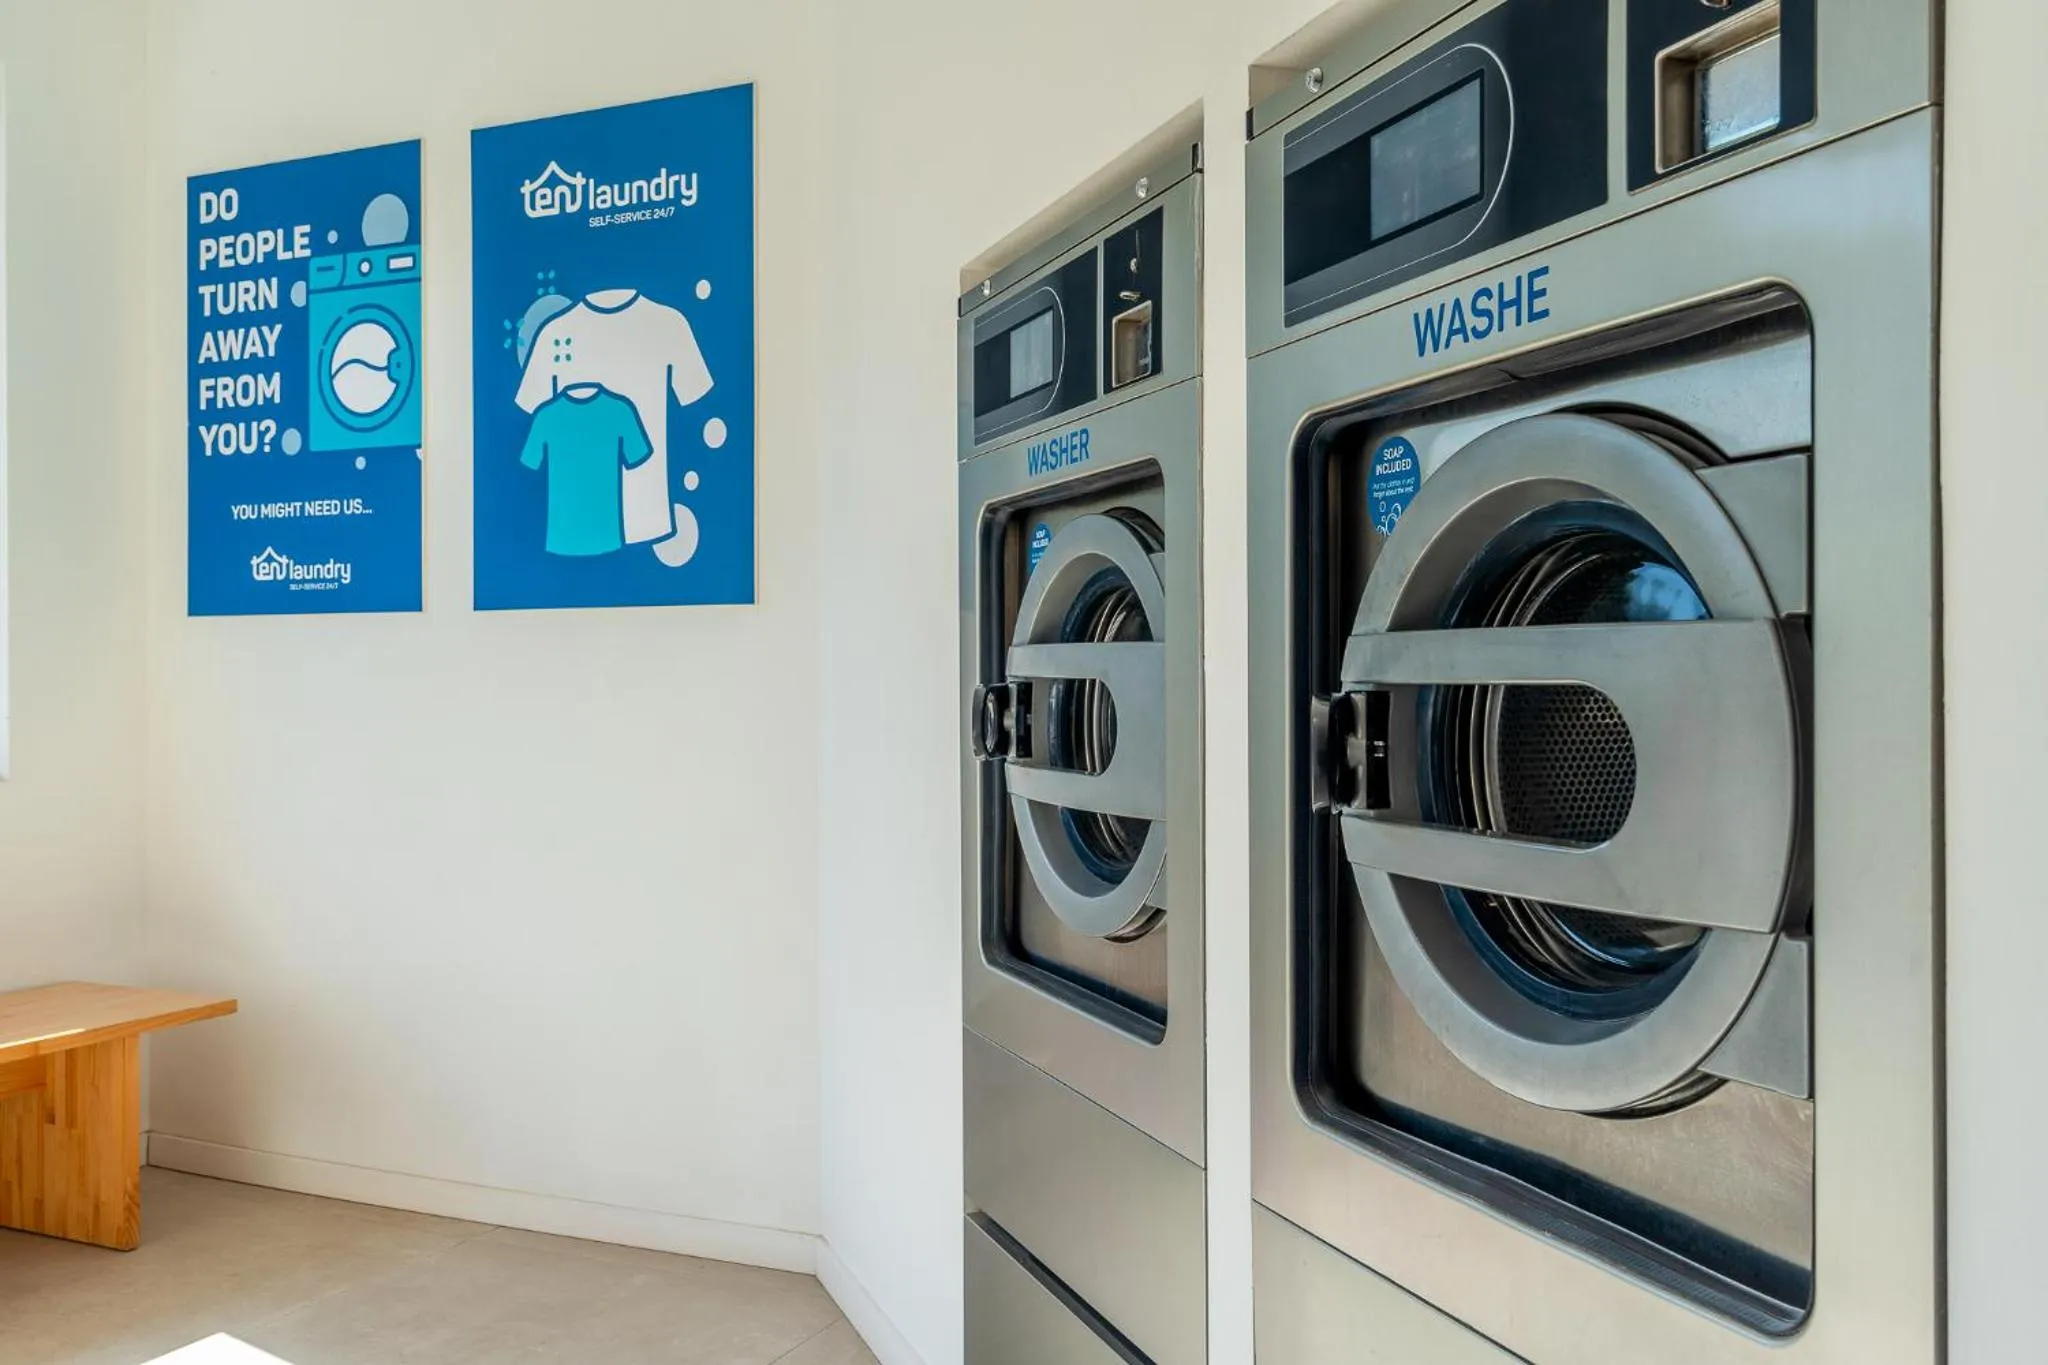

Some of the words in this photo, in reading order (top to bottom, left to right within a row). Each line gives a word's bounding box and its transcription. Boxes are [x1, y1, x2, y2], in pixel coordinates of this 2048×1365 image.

[199, 188, 239, 225] DO
[588, 167, 698, 210] laundry
[589, 209, 652, 228] SELF-SERVICE
[653, 206, 676, 219] 24/7
[199, 224, 312, 271] PEOPLE
[198, 277, 278, 317] TURN
[1413, 265, 1550, 358] WASHE
[197, 324, 283, 364] AWAY
[199, 372, 281, 411] FROM
[198, 419, 277, 457] YOU?
[1027, 427, 1090, 477] WASHER
[1383, 446, 1404, 461] SOAP
[1375, 458, 1412, 476] INCLUDED
[231, 504, 258, 520] YOU
[260, 502, 302, 519] MIGHT
[304, 500, 341, 517] NEED
[343, 498, 373, 515] US...
[289, 558, 351, 584] laundry
